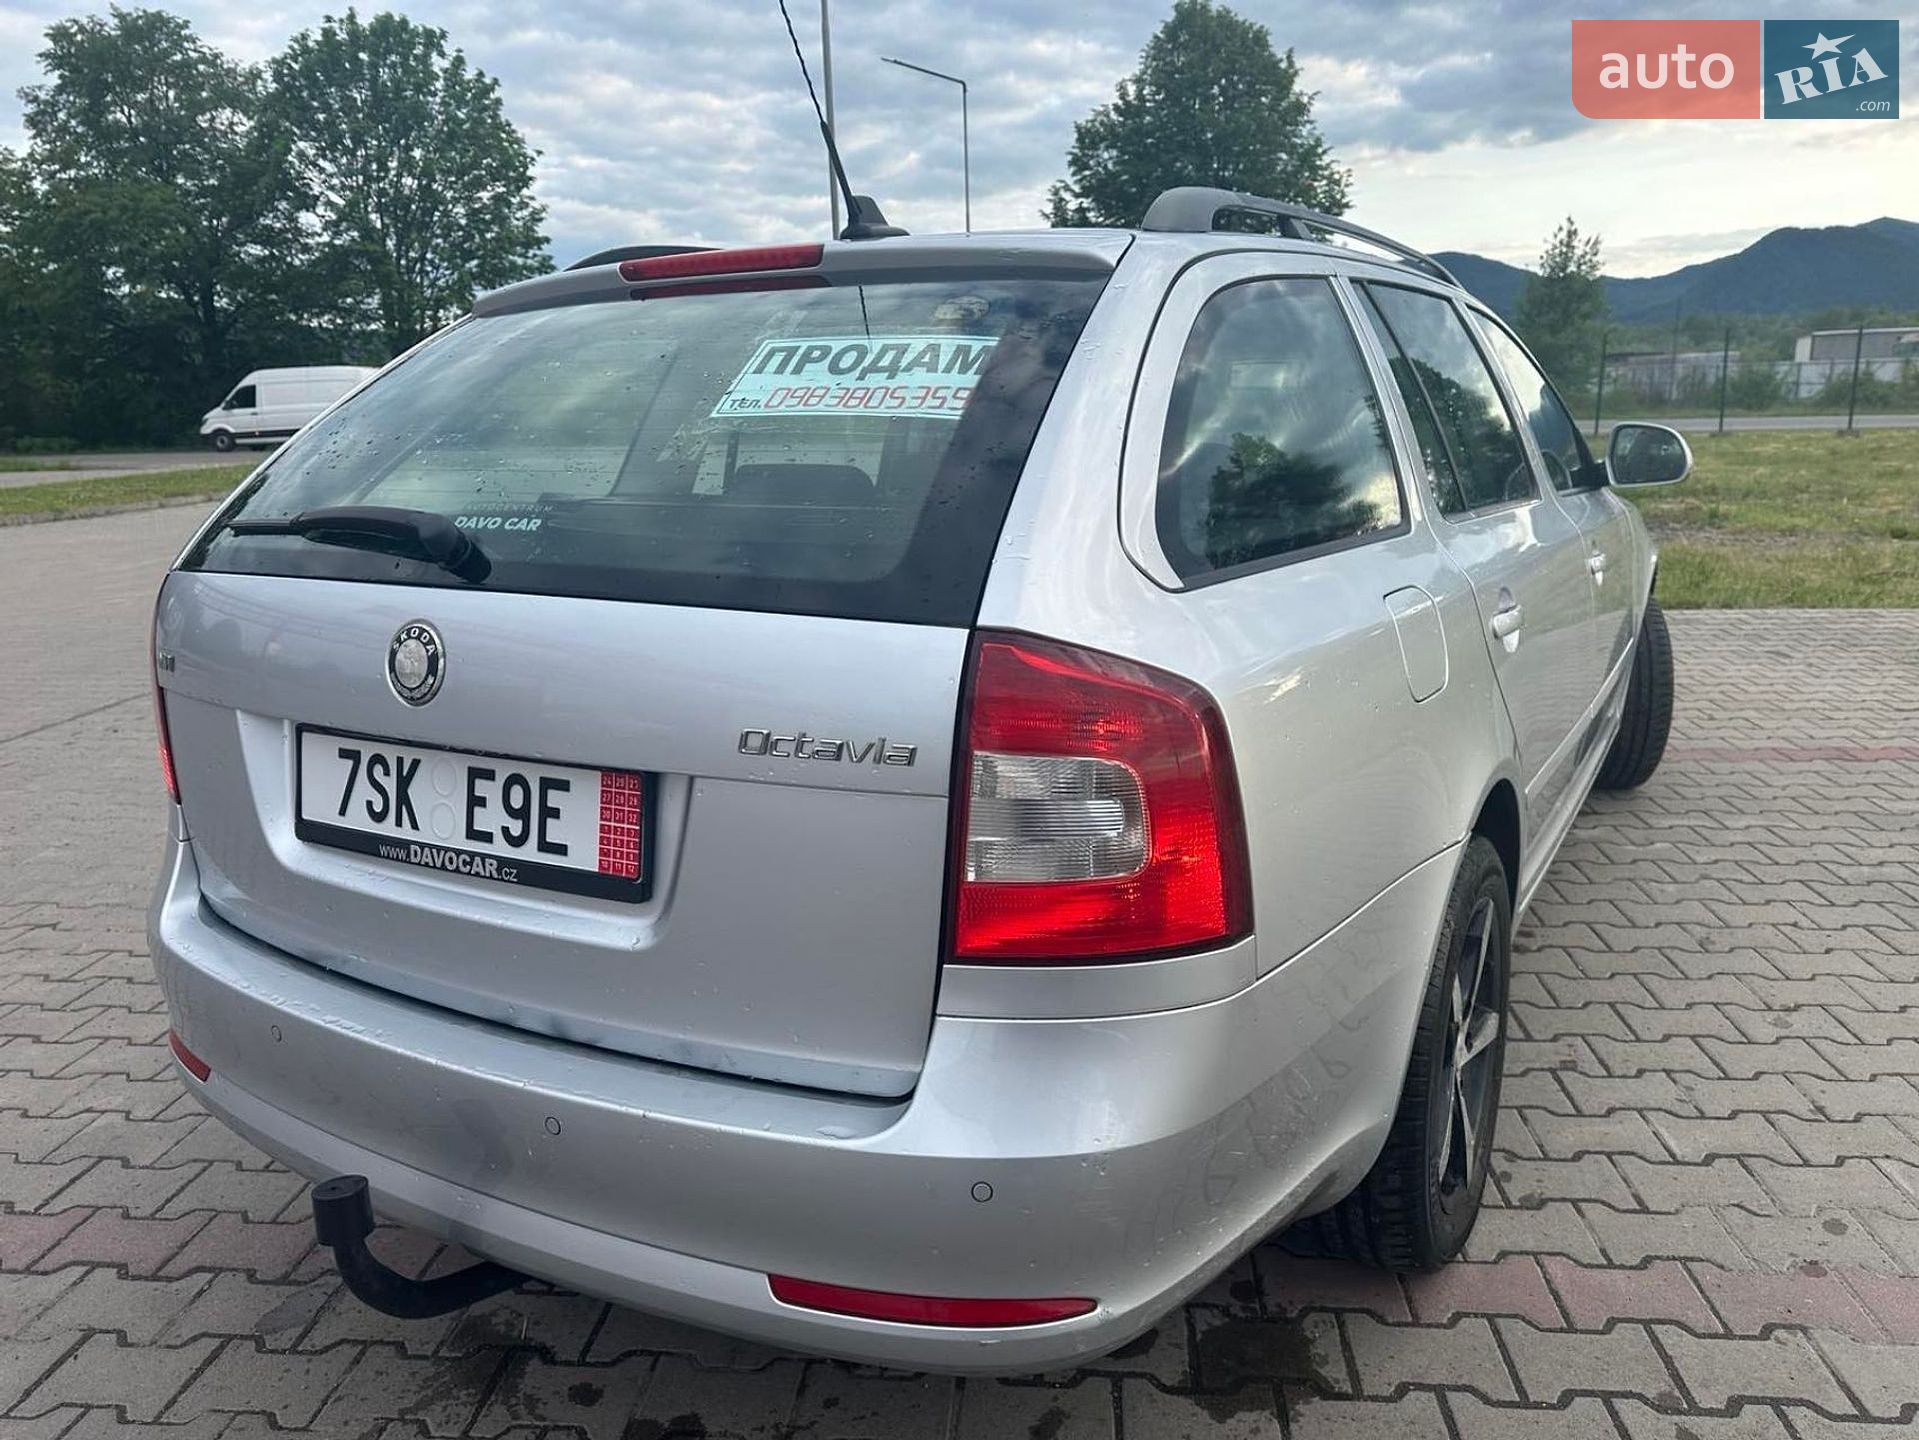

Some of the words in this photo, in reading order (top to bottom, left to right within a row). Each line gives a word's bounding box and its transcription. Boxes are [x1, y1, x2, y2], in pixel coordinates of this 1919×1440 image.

[751, 343, 994, 381] ПРОДАМ
[764, 386, 975, 410] 0983805359
[454, 516, 502, 529] DAVO
[504, 517, 542, 531] CAR
[738, 727, 918, 767] Octavia
[338, 747, 421, 831] 7SK
[465, 766, 571, 856] E9E
[379, 844, 518, 882] www.DAVOCAR.cz
